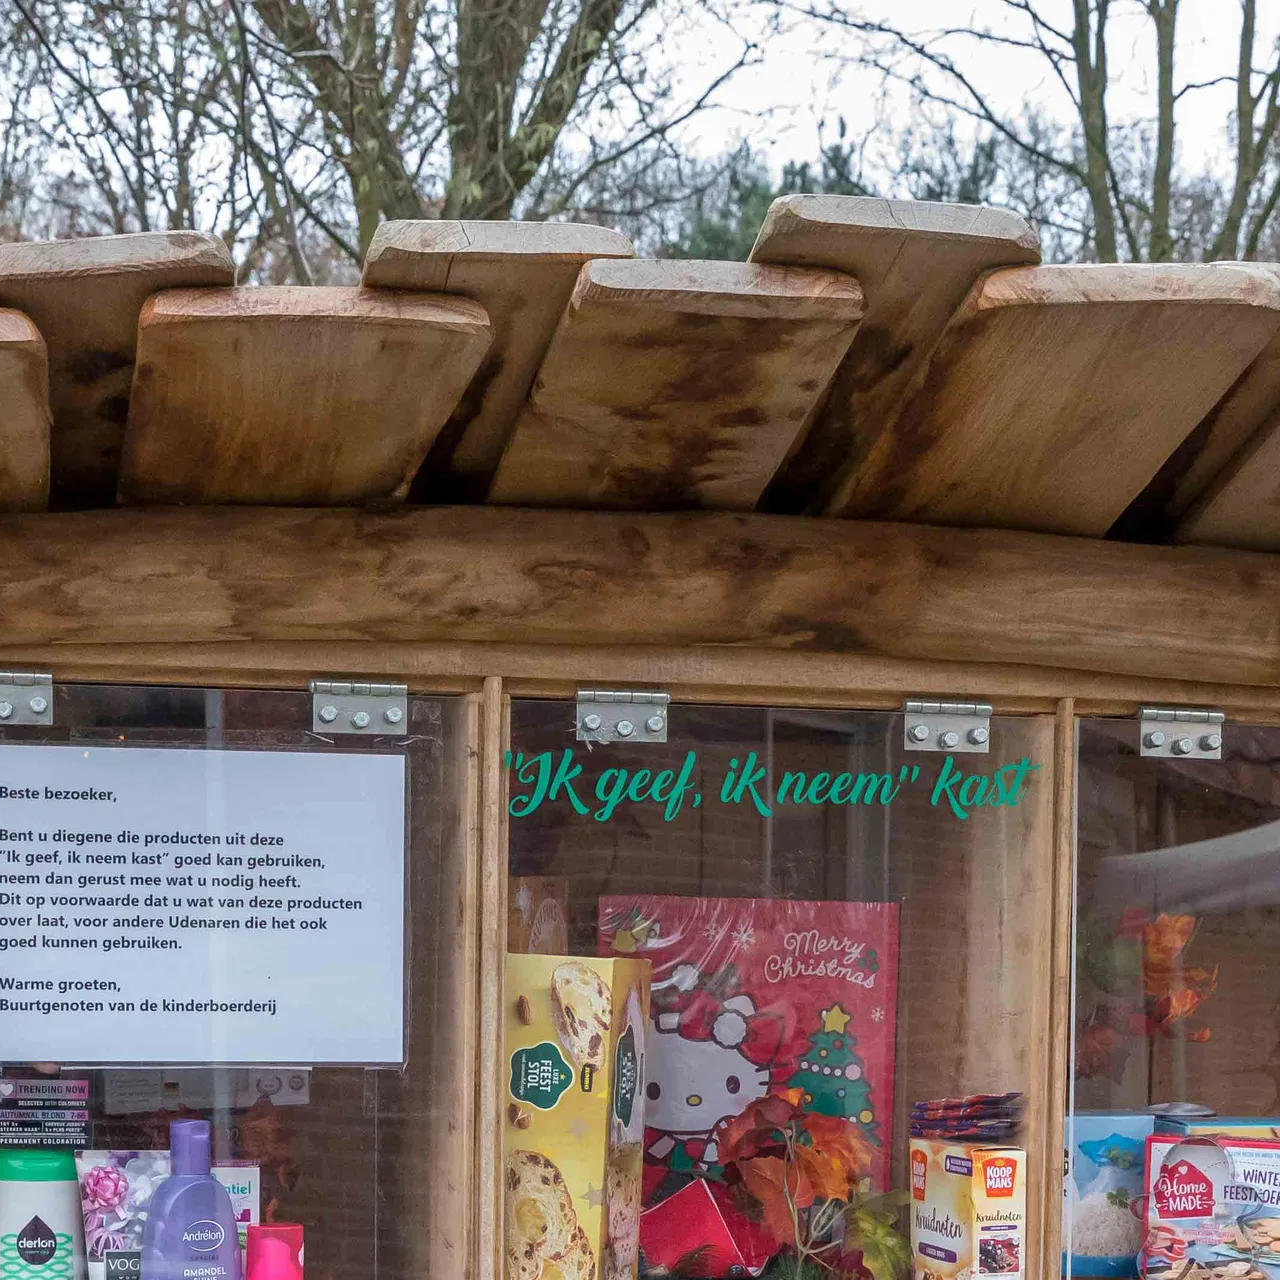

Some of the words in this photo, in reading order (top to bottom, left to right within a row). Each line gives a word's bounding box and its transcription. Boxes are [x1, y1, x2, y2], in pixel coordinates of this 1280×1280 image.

[595, 751, 702, 821] geef,
[720, 752, 772, 817] ik
[930, 756, 1043, 820] kast
[44, 788, 118, 803] bezoeker,
[37, 833, 48, 843] u
[52, 830, 113, 847] diegene
[116, 831, 140, 844] die
[144, 832, 221, 849] producten
[224, 832, 246, 845] uit
[249, 833, 285, 846] deze
[24, 851, 63, 868] geef,
[67, 852, 81, 865] ik
[85, 855, 128, 865] neem
[173, 853, 213, 870] goed
[216, 854, 244, 867] kan
[247, 854, 326, 871] gebruiken,
[45, 873, 74, 886] dan
[77, 874, 126, 890] gerust
[129, 877, 164, 887] mee
[166, 875, 194, 887] wat
[197, 877, 208, 887] u
[211, 875, 254, 892] nodig
[258, 875, 301, 888] heeft.
[25, 896, 46, 910] op
[49, 894, 141, 907] voorwaarde
[143, 895, 169, 908] dat
[172, 898, 182, 908] u
[185, 896, 214, 908] wat
[217, 899, 245, 909] van
[248, 896, 283, 909] deze
[286, 897, 363, 914] producten
[36, 915, 69, 930] laat,
[73, 918, 109, 928] voor
[112, 915, 164, 928] andere
[168, 916, 241, 929] Udenaren
[244, 916, 269, 929] die
[271, 917, 296, 930] het
[299, 917, 328, 930] ook
[41, 936, 99, 949] kunnen
[102, 936, 183, 953] gebruiken.
[784, 930, 867, 964] Merry
[764, 956, 876, 990] Christmas
[58, 979, 122, 995] groeten,
[108, 1002, 135, 1012] van
[139, 999, 159, 1012] de
[161, 1000, 278, 1017] kinderboerderij
[527, 1061, 540, 1088] STOL
[539, 1060, 552, 1092] FEEST
[19, 1086, 62, 1094] TRENDING
[65, 1085, 86, 1093] NOW
[0, 1110, 38, 1119] AUTUMNAL
[41, 1110, 66, 1119] BLOND
[986, 1166, 1012, 1177] KOOP
[986, 1178, 1012, 1188] MANS
[1158, 1173, 1208, 1196] Home
[1170, 1195, 1203, 1211] MADE
[915, 1207, 962, 1239] Kruidnoten
[976, 1210, 1022, 1222] Kruidnoten
[18, 1238, 55, 1249] derlon
[182, 1229, 221, 1241] Andrélon
[184, 1267, 227, 1277] AMANDEL
